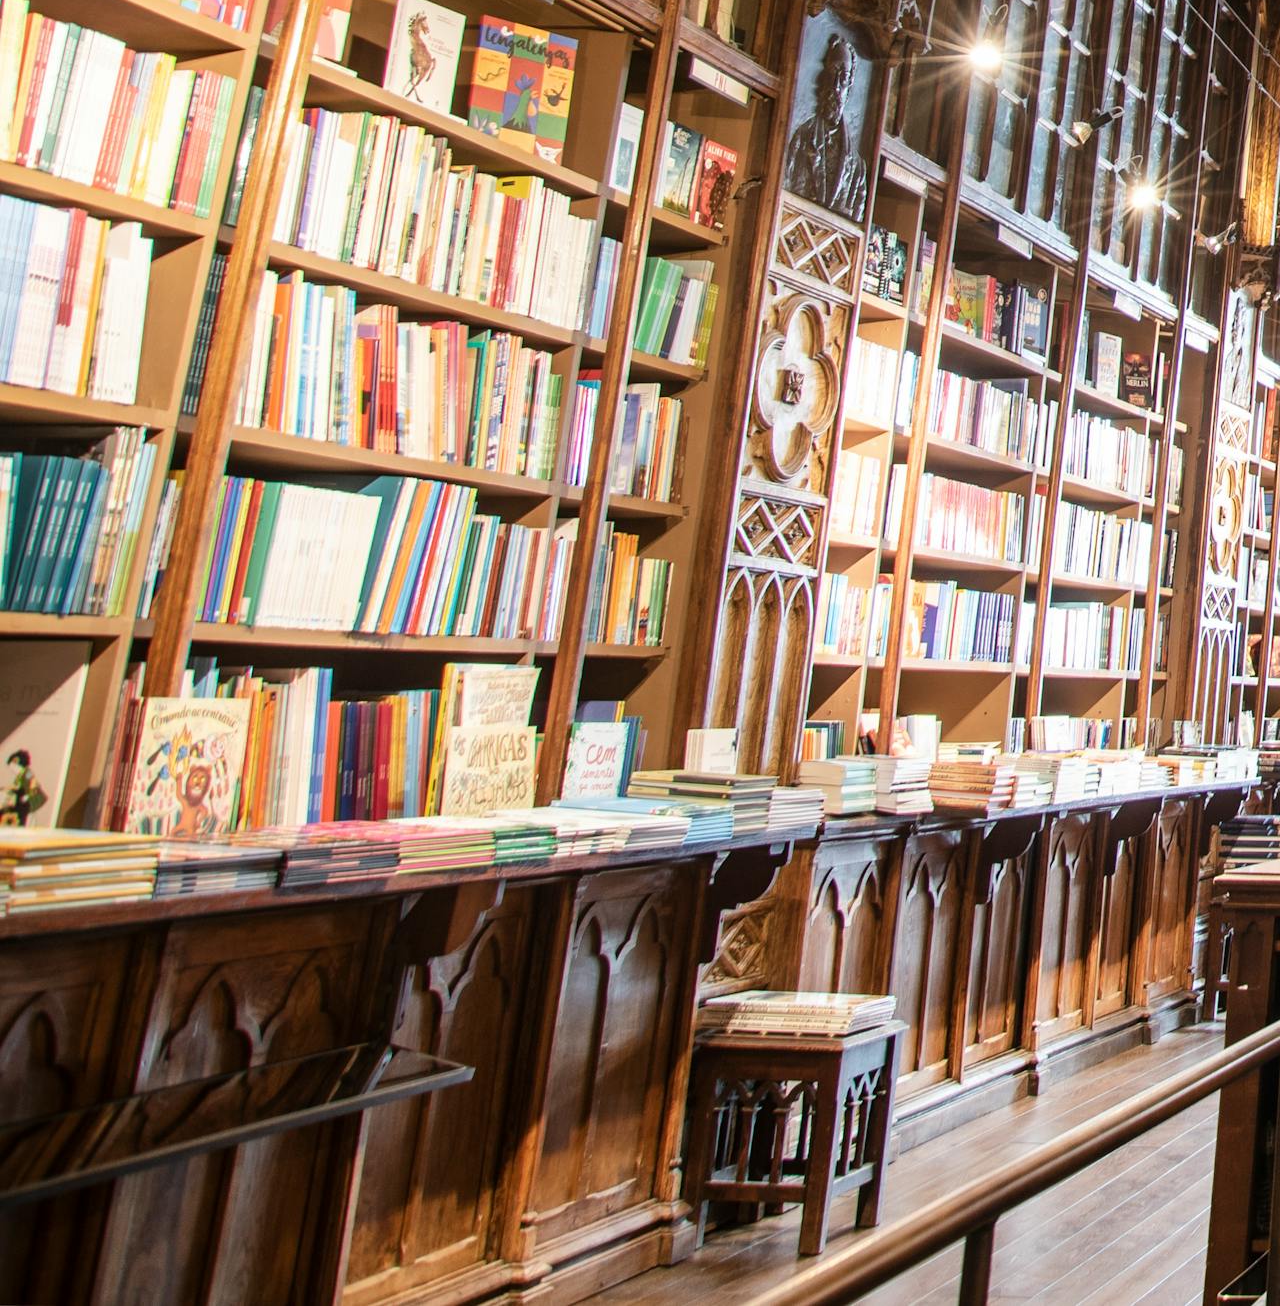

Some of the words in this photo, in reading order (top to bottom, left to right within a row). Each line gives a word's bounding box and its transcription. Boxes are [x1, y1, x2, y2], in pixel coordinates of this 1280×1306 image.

[714, 72, 728, 93] PNL
[1126, 375, 1149, 388] MERLIN
[586, 743, 617, 766] Cem
